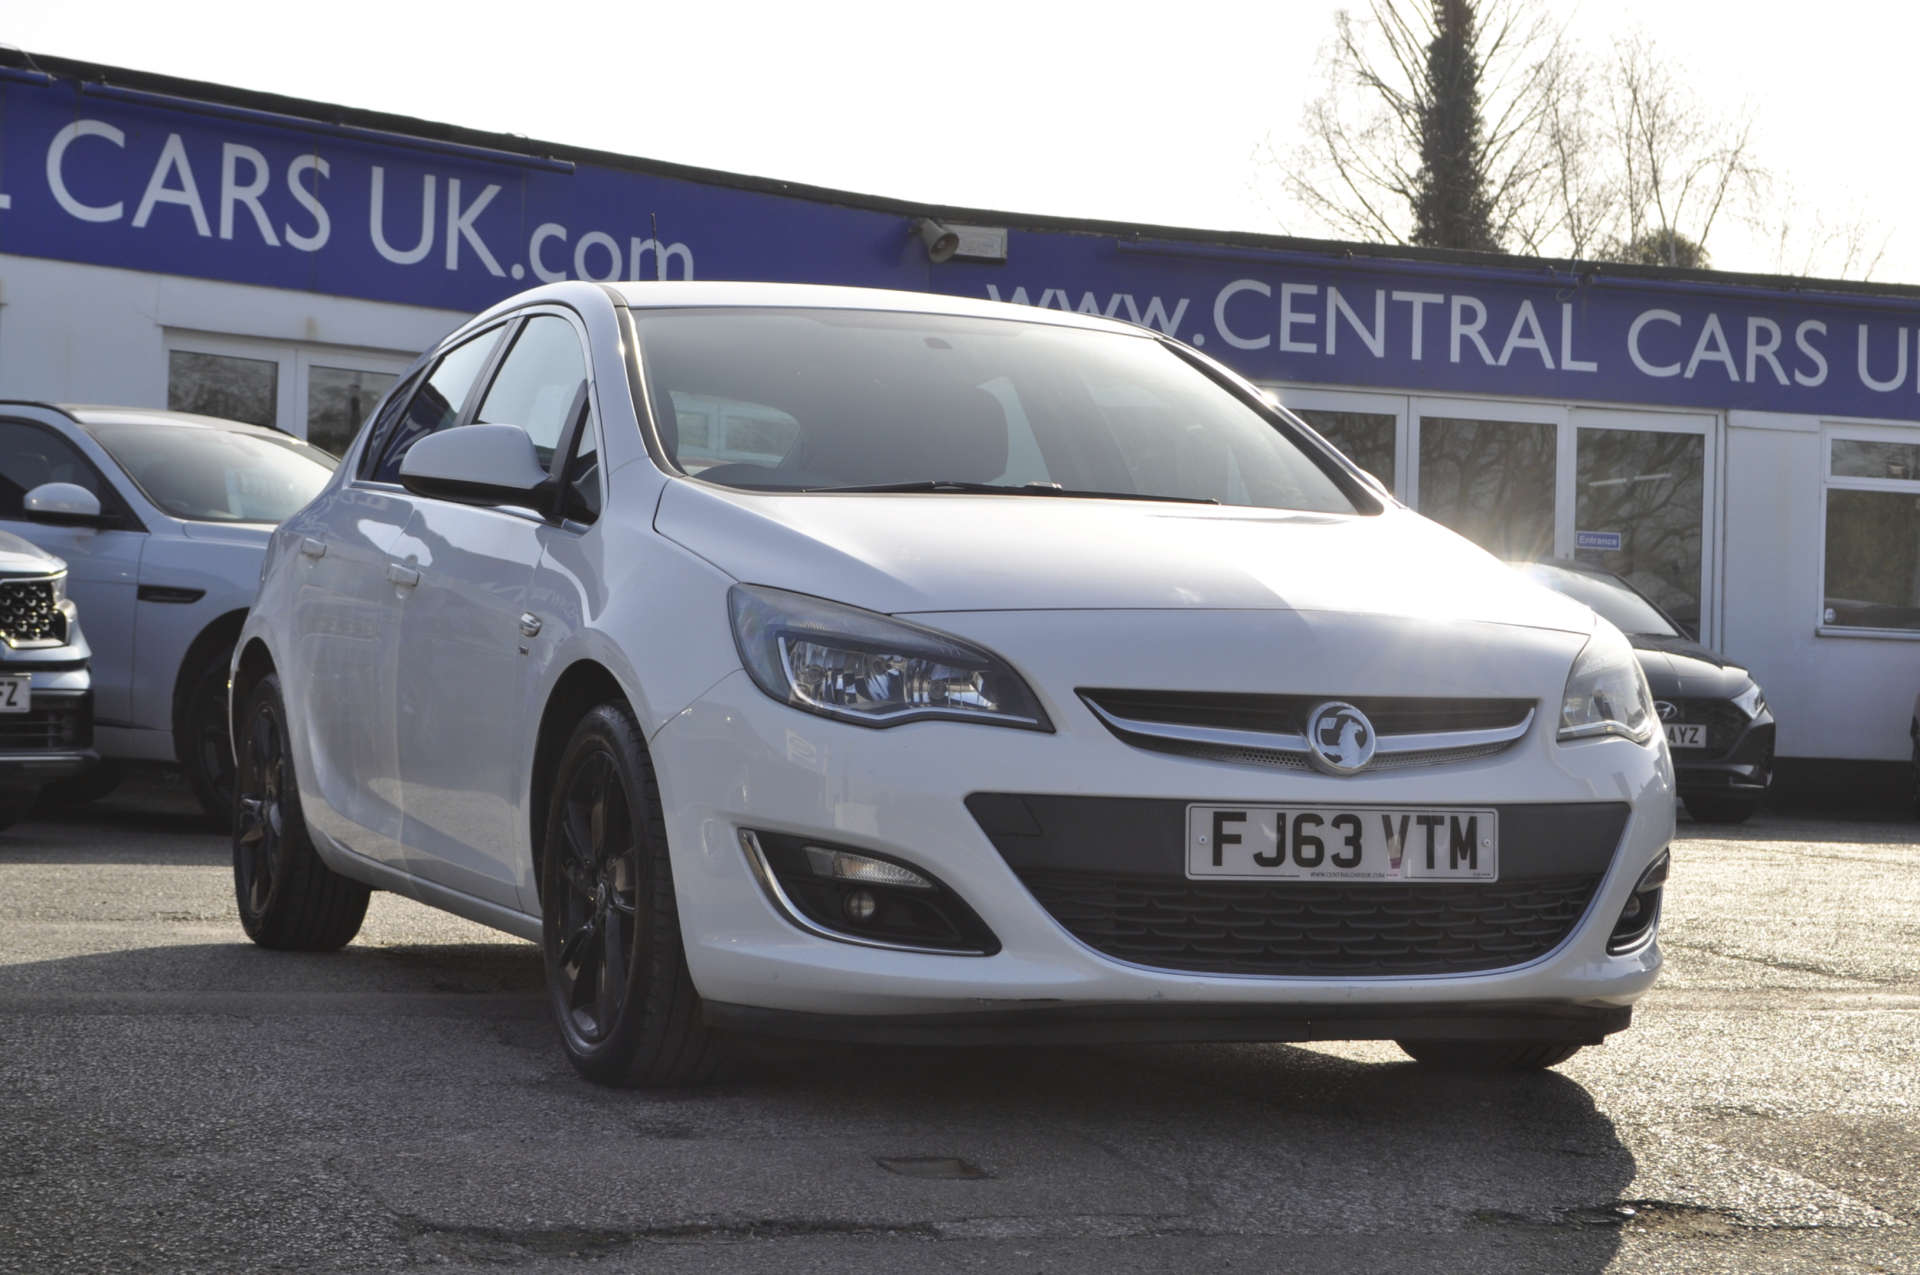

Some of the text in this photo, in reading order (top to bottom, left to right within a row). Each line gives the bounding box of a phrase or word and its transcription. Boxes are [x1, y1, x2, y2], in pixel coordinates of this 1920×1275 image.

[46, 119, 695, 283] CARS UK.com
[1626, 308, 1829, 388] CARS
[1857, 323, 1920, 394] U
[1668, 727, 1699, 744] AYZ
[1212, 811, 1478, 870] FJ63 VTM
